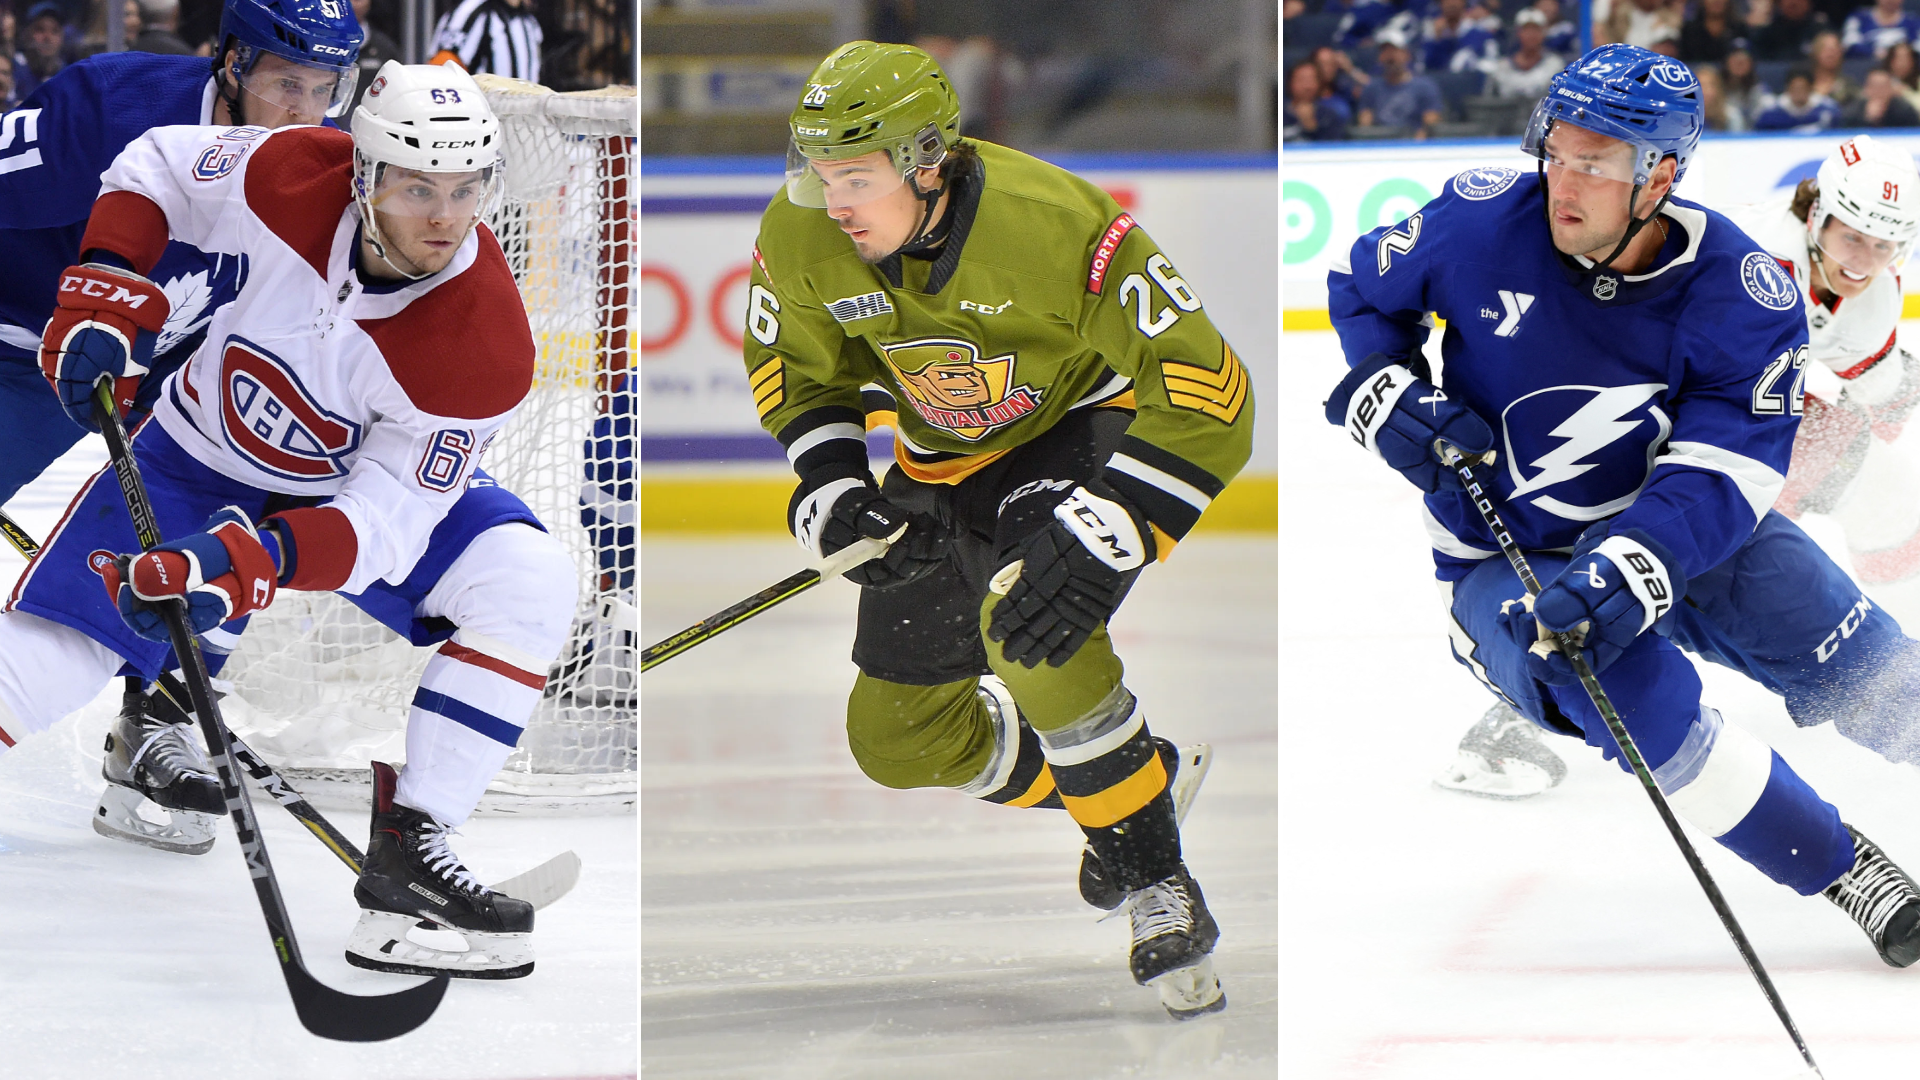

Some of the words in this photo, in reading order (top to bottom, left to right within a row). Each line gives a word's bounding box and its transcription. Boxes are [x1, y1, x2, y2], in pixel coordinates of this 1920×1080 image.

[320, 0, 341, 19] 51
[312, 44, 350, 56] CCM
[1576, 60, 1613, 78] 22
[1655, 65, 1693, 84] TGH
[430, 88, 462, 104] 63
[803, 84, 831, 105] 26
[1557, 87, 1593, 104] BAUER
[797, 126, 829, 136] CCM
[432, 140, 476, 149] CCM
[1463, 176, 1512, 196] LIGHTNING
[1882, 181, 1898, 202] 91
[1869, 211, 1902, 225] CCM
[1091, 228, 1122, 282] NORTH
[1118, 214, 1135, 229] BA
[1377, 212, 1423, 277] 2
[1745, 260, 1754, 278] BAY
[1751, 255, 1791, 284] LIGHTNING
[60, 276, 149, 309] CCM
[1119, 252, 1203, 340] 26
[1747, 280, 1775, 305] TAMPA
[748, 284, 781, 346] 6
[824, 290, 893, 323] OHL
[959, 299, 1013, 315] CCM
[1480, 307, 1499, 319] the
[1752, 344, 1809, 416] 22
[122, 398, 134, 407] CC
[901, 388, 1036, 428] BATTALION
[1351, 372, 1396, 448] UER
[115, 455, 152, 548] RIBCORE
[998, 479, 1075, 518] CCM
[1458, 465, 1514, 548] PROTO
[866, 510, 890, 526] CCM
[3, 523, 30, 548] SUPER
[152, 555, 169, 586] CCM
[1622, 552, 1669, 622] BAU
[652, 626, 701, 655] SUPER
[1811, 593, 1873, 664] CCM
[231, 735, 302, 807] CM
[212, 753, 268, 880] CCM
[410, 883, 446, 904] BAUER
